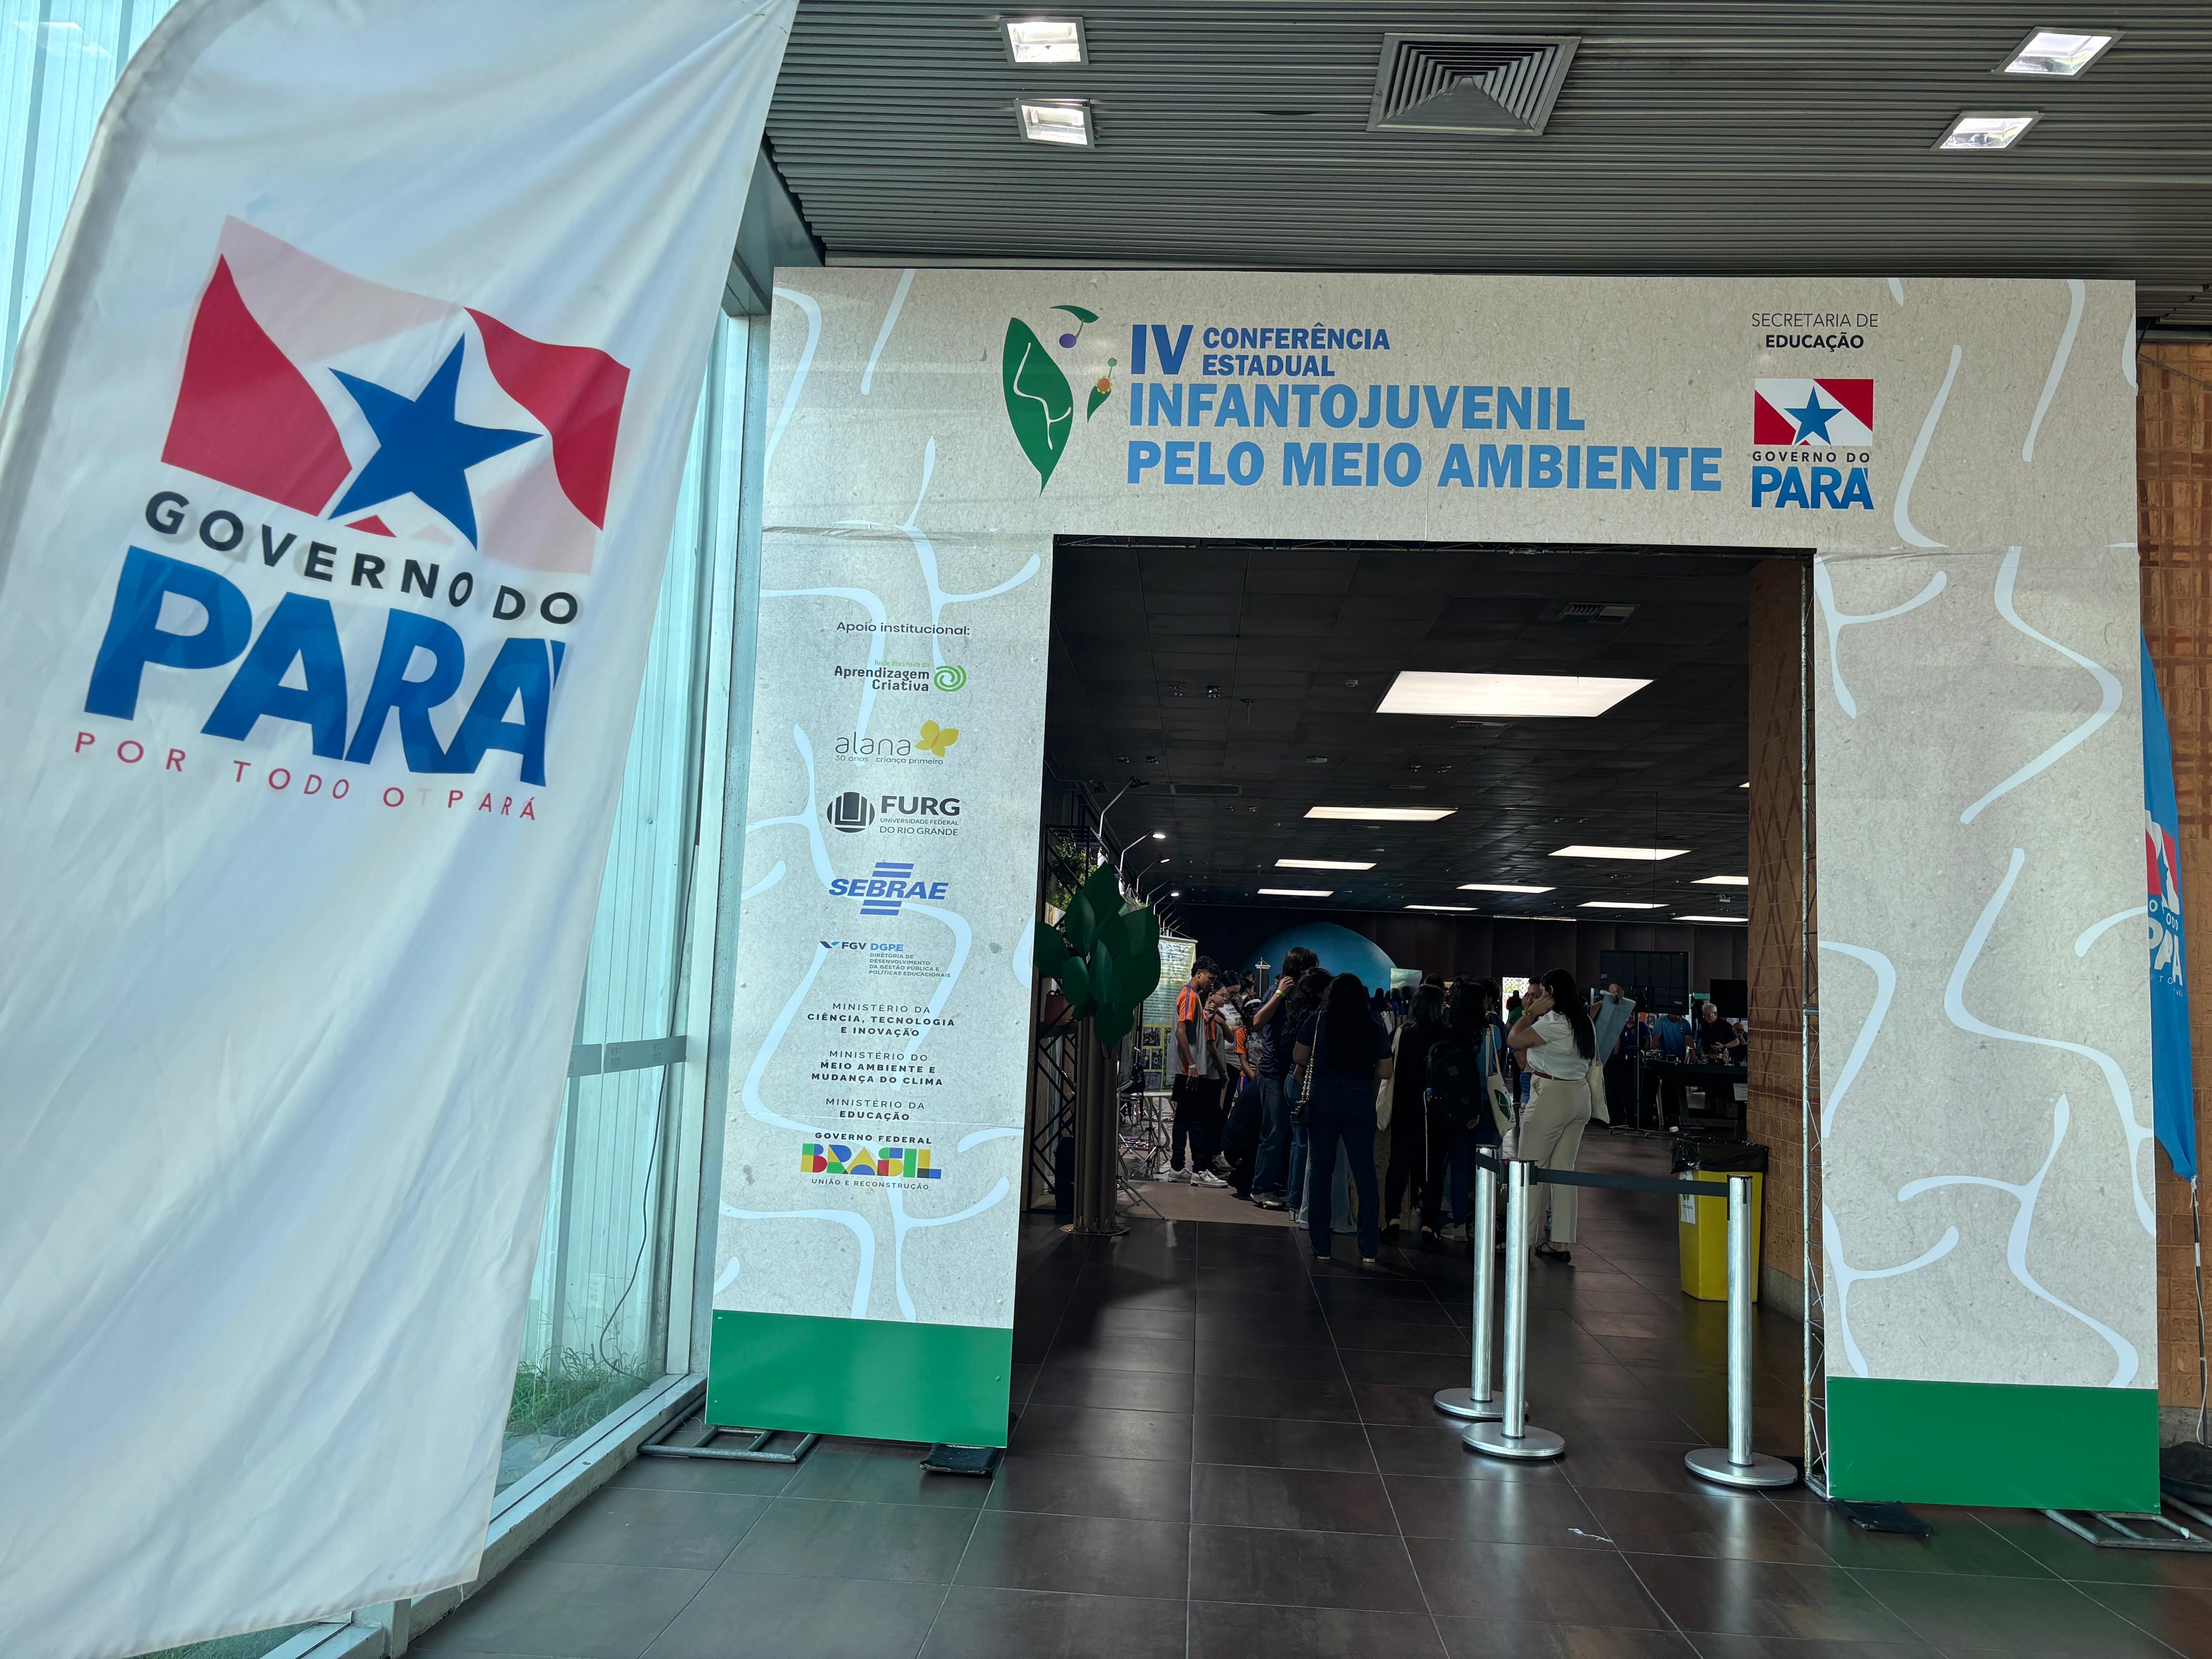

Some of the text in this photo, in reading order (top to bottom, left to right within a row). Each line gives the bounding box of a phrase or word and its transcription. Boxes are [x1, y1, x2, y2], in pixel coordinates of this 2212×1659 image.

[1752, 313, 1879, 328] SECRETARIA DE
[1203, 322, 1390, 350] CONFERÊNCIA
[1766, 332, 1864, 353] EDUCAÇÃO
[1130, 324, 1194, 375] IV
[1202, 354, 1335, 377] ESTADUAL
[1129, 382, 1585, 431] INFANTOJUVENIL
[1752, 450, 1870, 463] GOVERNO DO
[1127, 440, 1722, 492] PELO MEIO AMBIENTE
[145, 491, 578, 625] GOVERNO DO
[836, 622, 970, 635] Apoio institucional:
[834, 666, 929, 681] Aprendizagem
[872, 679, 929, 691] Criativa
[835, 732, 910, 756] alana
[75, 731, 536, 821] POR TODO O PARÁ
[881, 795, 960, 816] FURG
[917, 827, 959, 836] GRANDE
[829, 878, 949, 900] SEBRAE
[870, 943, 904, 951] DGPE
[833, 1003, 908, 1012] MINISTÉRIO
[807, 1013, 954, 1026] CIÊNCIA, TECNOLOGIA
[853, 1027, 919, 1037] INOVAÇÃO
[830, 1051, 904, 1060] MINISTÉRIO
[857, 1063, 923, 1073] AMBIENTE
[811, 1073, 874, 1084] MUDANÇA
[826, 1098, 902, 1108] MINISTÉRIO
[840, 1111, 910, 1121] EDUCAÇÃO
[815, 1132, 932, 1144] GOVERNO FEDERAL
[801, 1143, 942, 1179] BRASIL
[854, 1181, 929, 1190] RECONSTRUÇÃO
